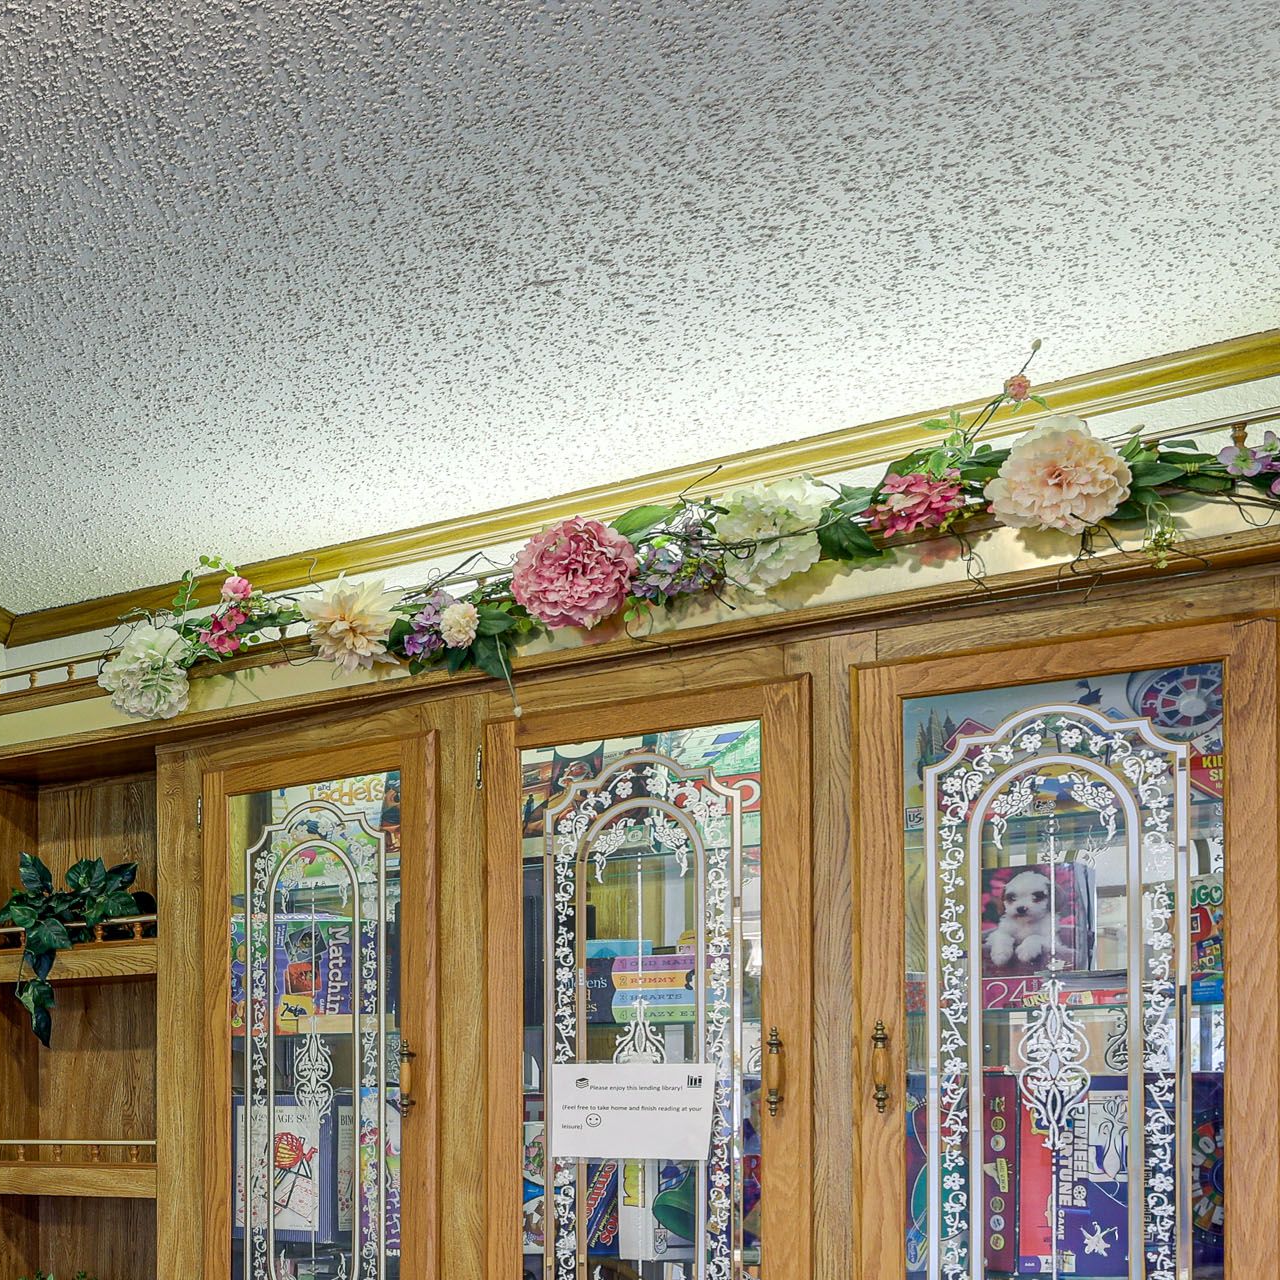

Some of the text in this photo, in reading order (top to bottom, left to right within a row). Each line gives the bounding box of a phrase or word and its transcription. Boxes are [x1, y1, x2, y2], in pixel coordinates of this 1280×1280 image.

[326, 926, 350, 1015] Matchin
[1057, 1127, 1073, 1241] ORTUNE GAME
